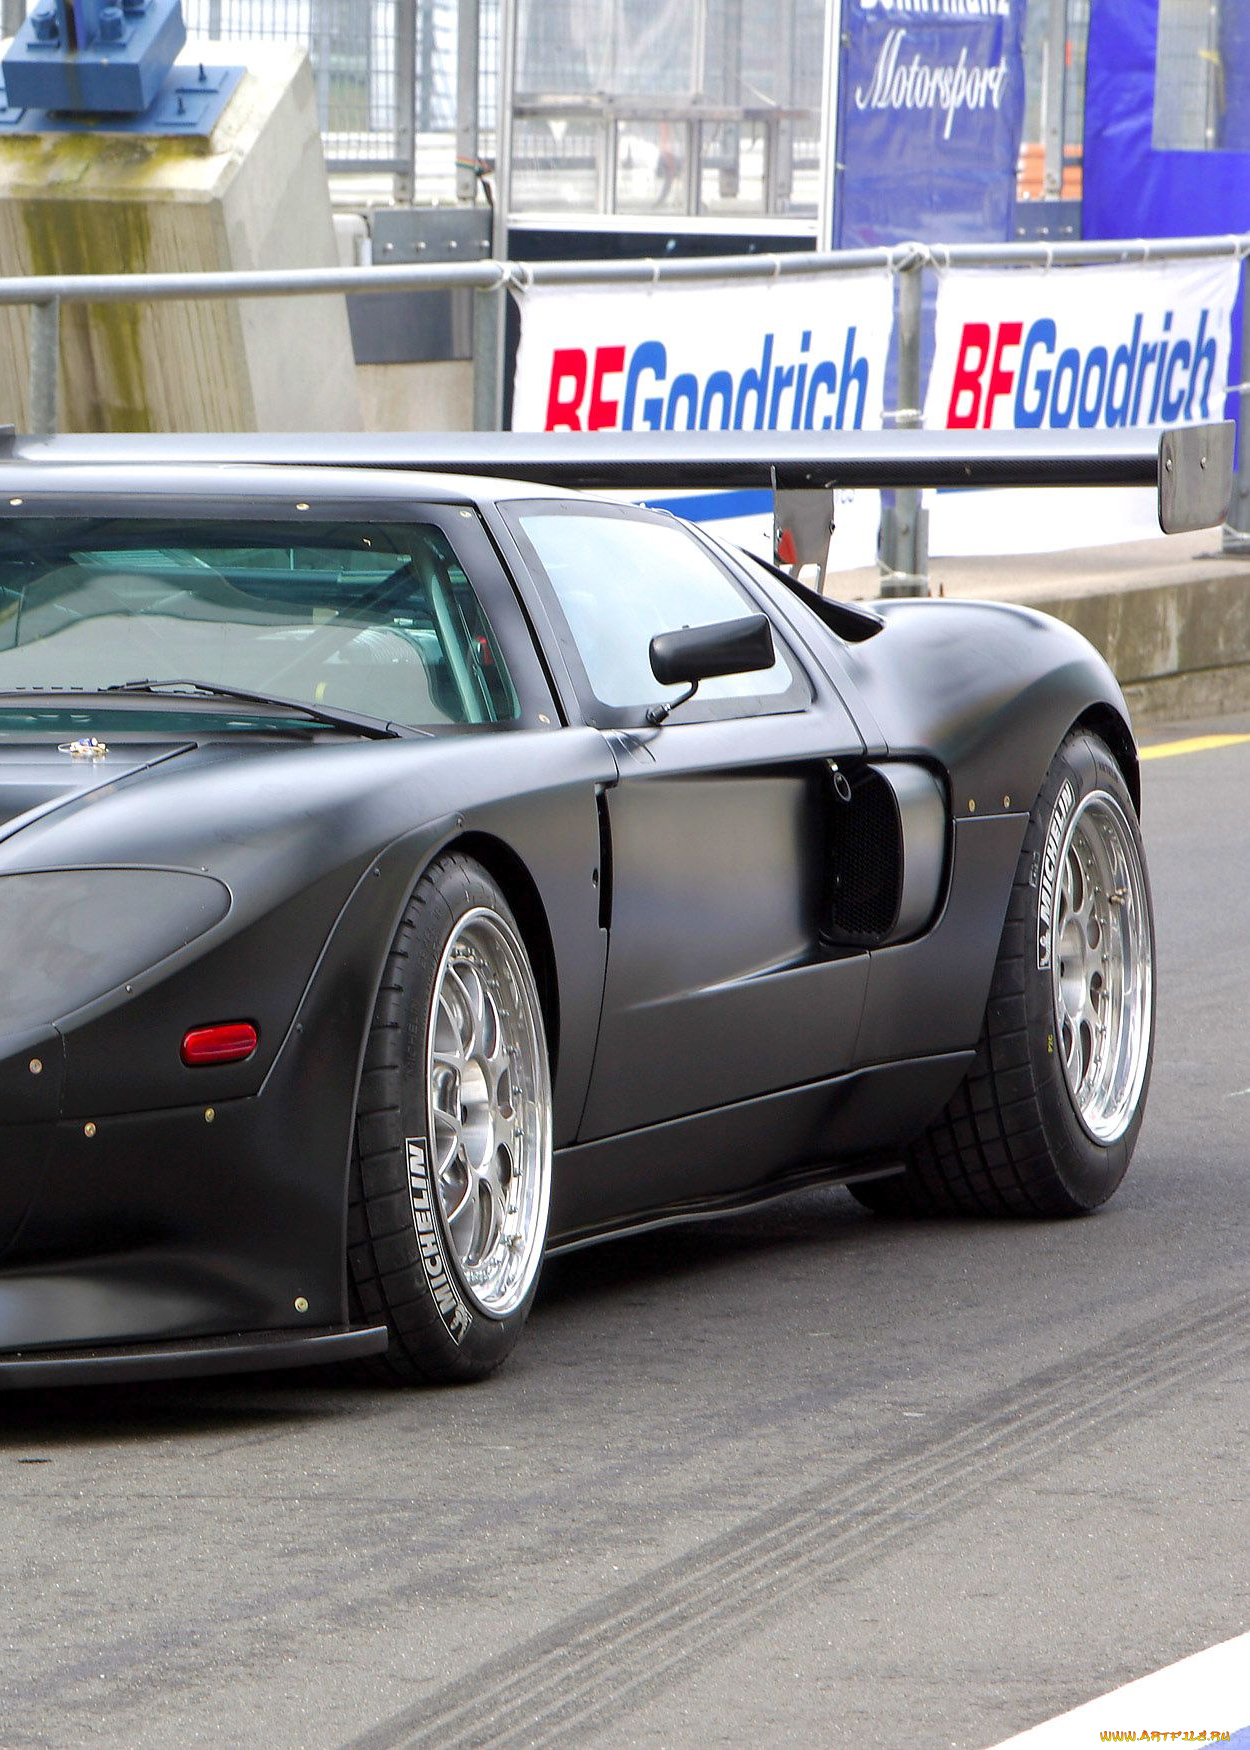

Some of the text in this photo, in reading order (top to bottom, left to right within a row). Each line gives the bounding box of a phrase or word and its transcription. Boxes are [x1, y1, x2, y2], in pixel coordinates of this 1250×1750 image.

[856, 29, 1008, 140] Motorsport
[544, 326, 869, 432] BFGoodrich
[945, 309, 1218, 430] BFGoodrich
[1041, 781, 1075, 926] MICHELIN
[407, 1142, 458, 1315] MICHELIN
